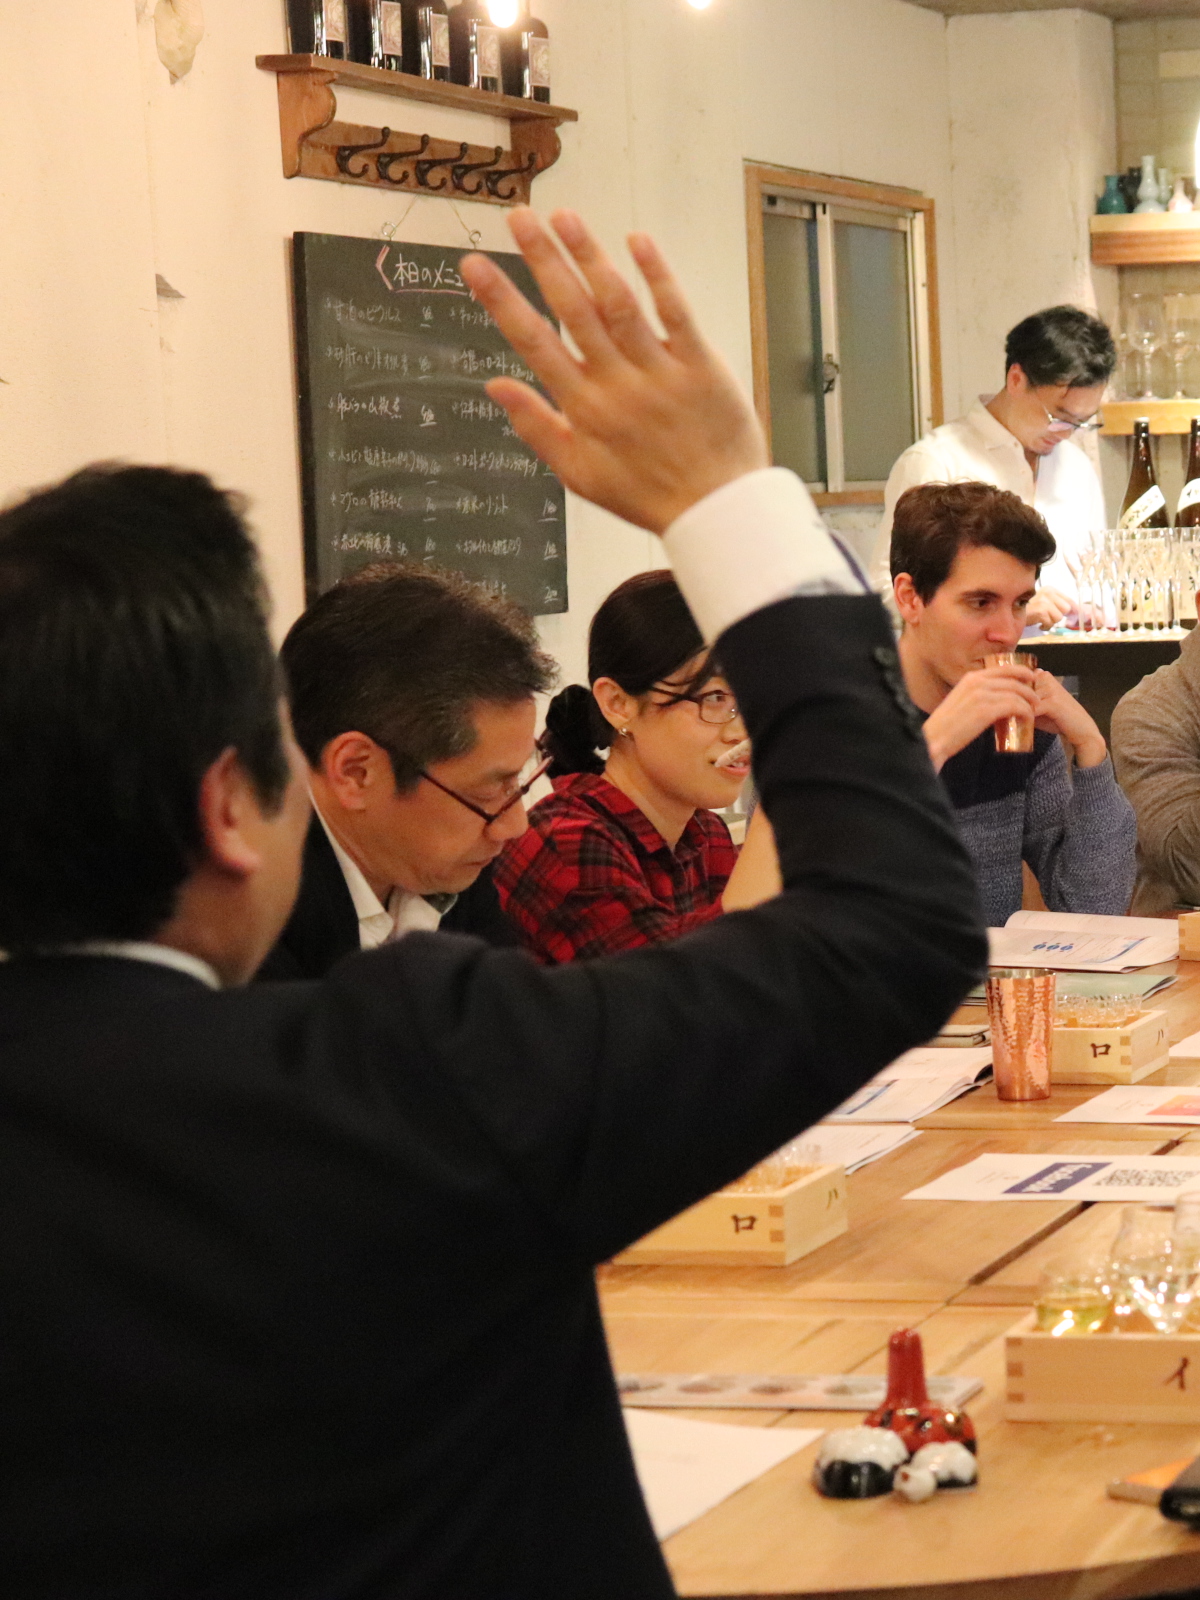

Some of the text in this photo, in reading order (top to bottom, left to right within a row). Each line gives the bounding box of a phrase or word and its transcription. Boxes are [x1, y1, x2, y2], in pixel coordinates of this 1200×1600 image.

[1090, 1042, 1111, 1058] ロ
[731, 1214, 757, 1234] ロ
[1162, 1356, 1190, 1391] イ
